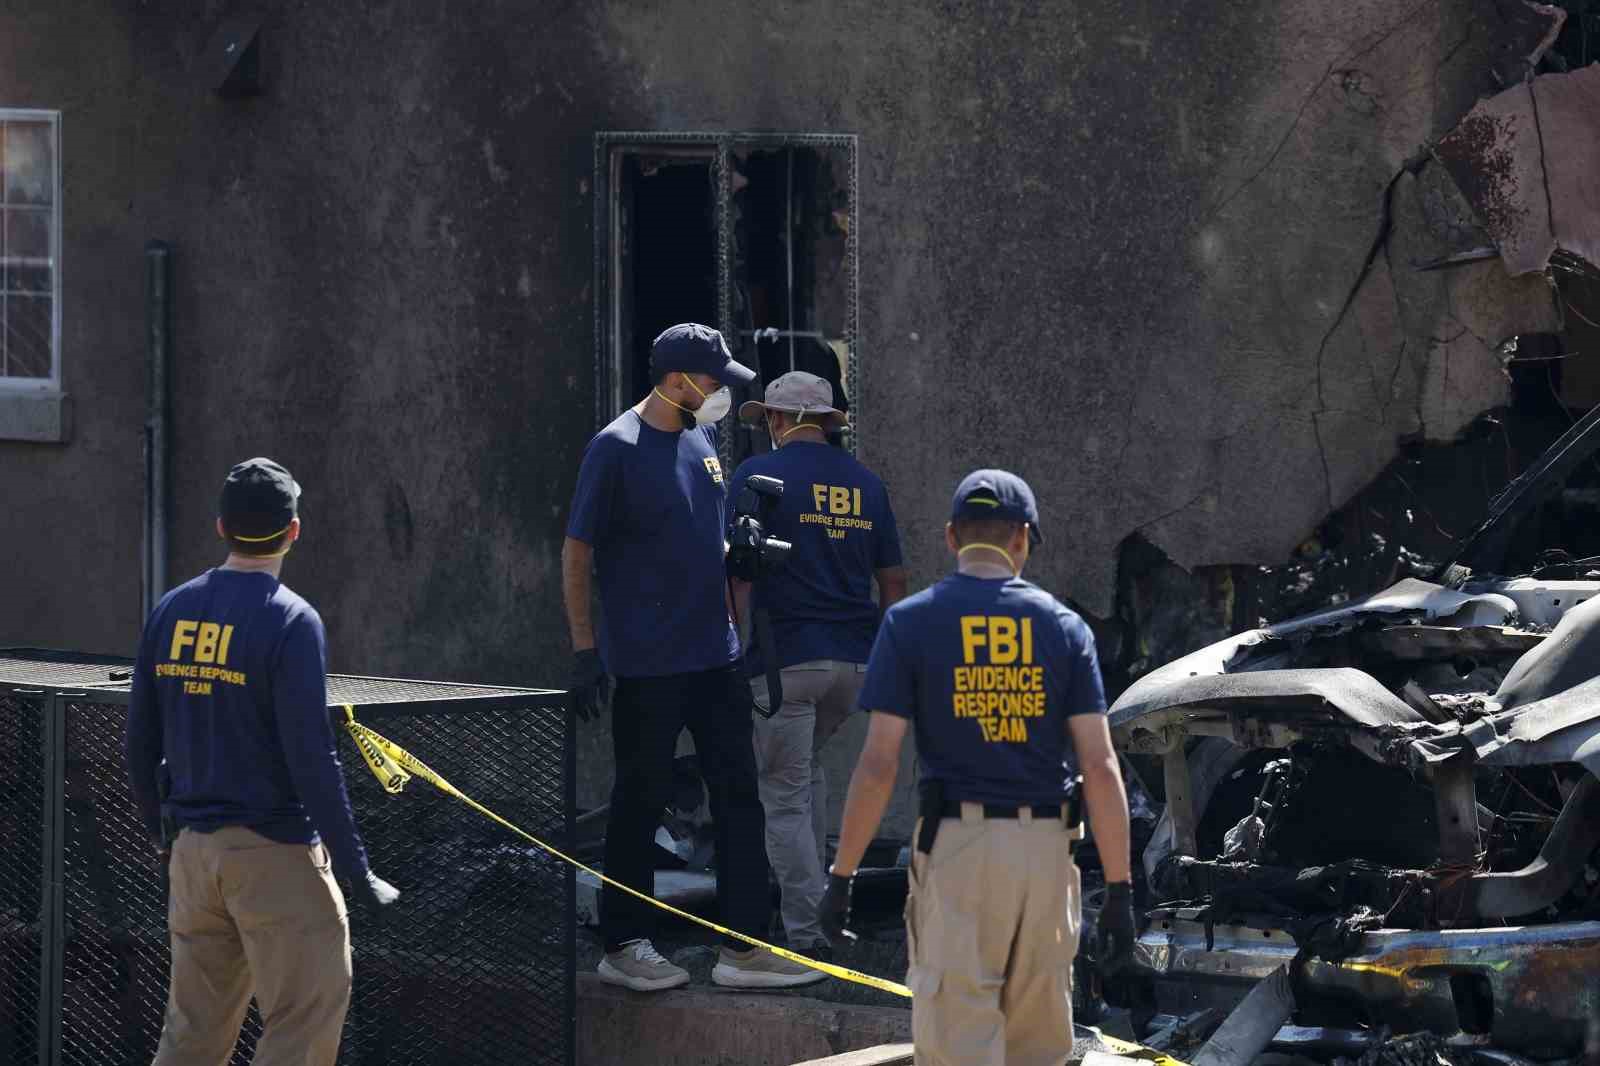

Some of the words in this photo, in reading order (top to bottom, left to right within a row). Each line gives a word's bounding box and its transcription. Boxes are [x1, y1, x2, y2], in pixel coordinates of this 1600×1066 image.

[703, 456, 721, 473] FB
[812, 483, 862, 516] FBI
[169, 619, 234, 666] FBI
[960, 615, 1033, 665] FBI
[183, 680, 212, 695] TEAM
[953, 666, 1044, 691] EVIDENCE
[953, 691, 1046, 718] RESPONSE
[977, 717, 1028, 742] TEAM
